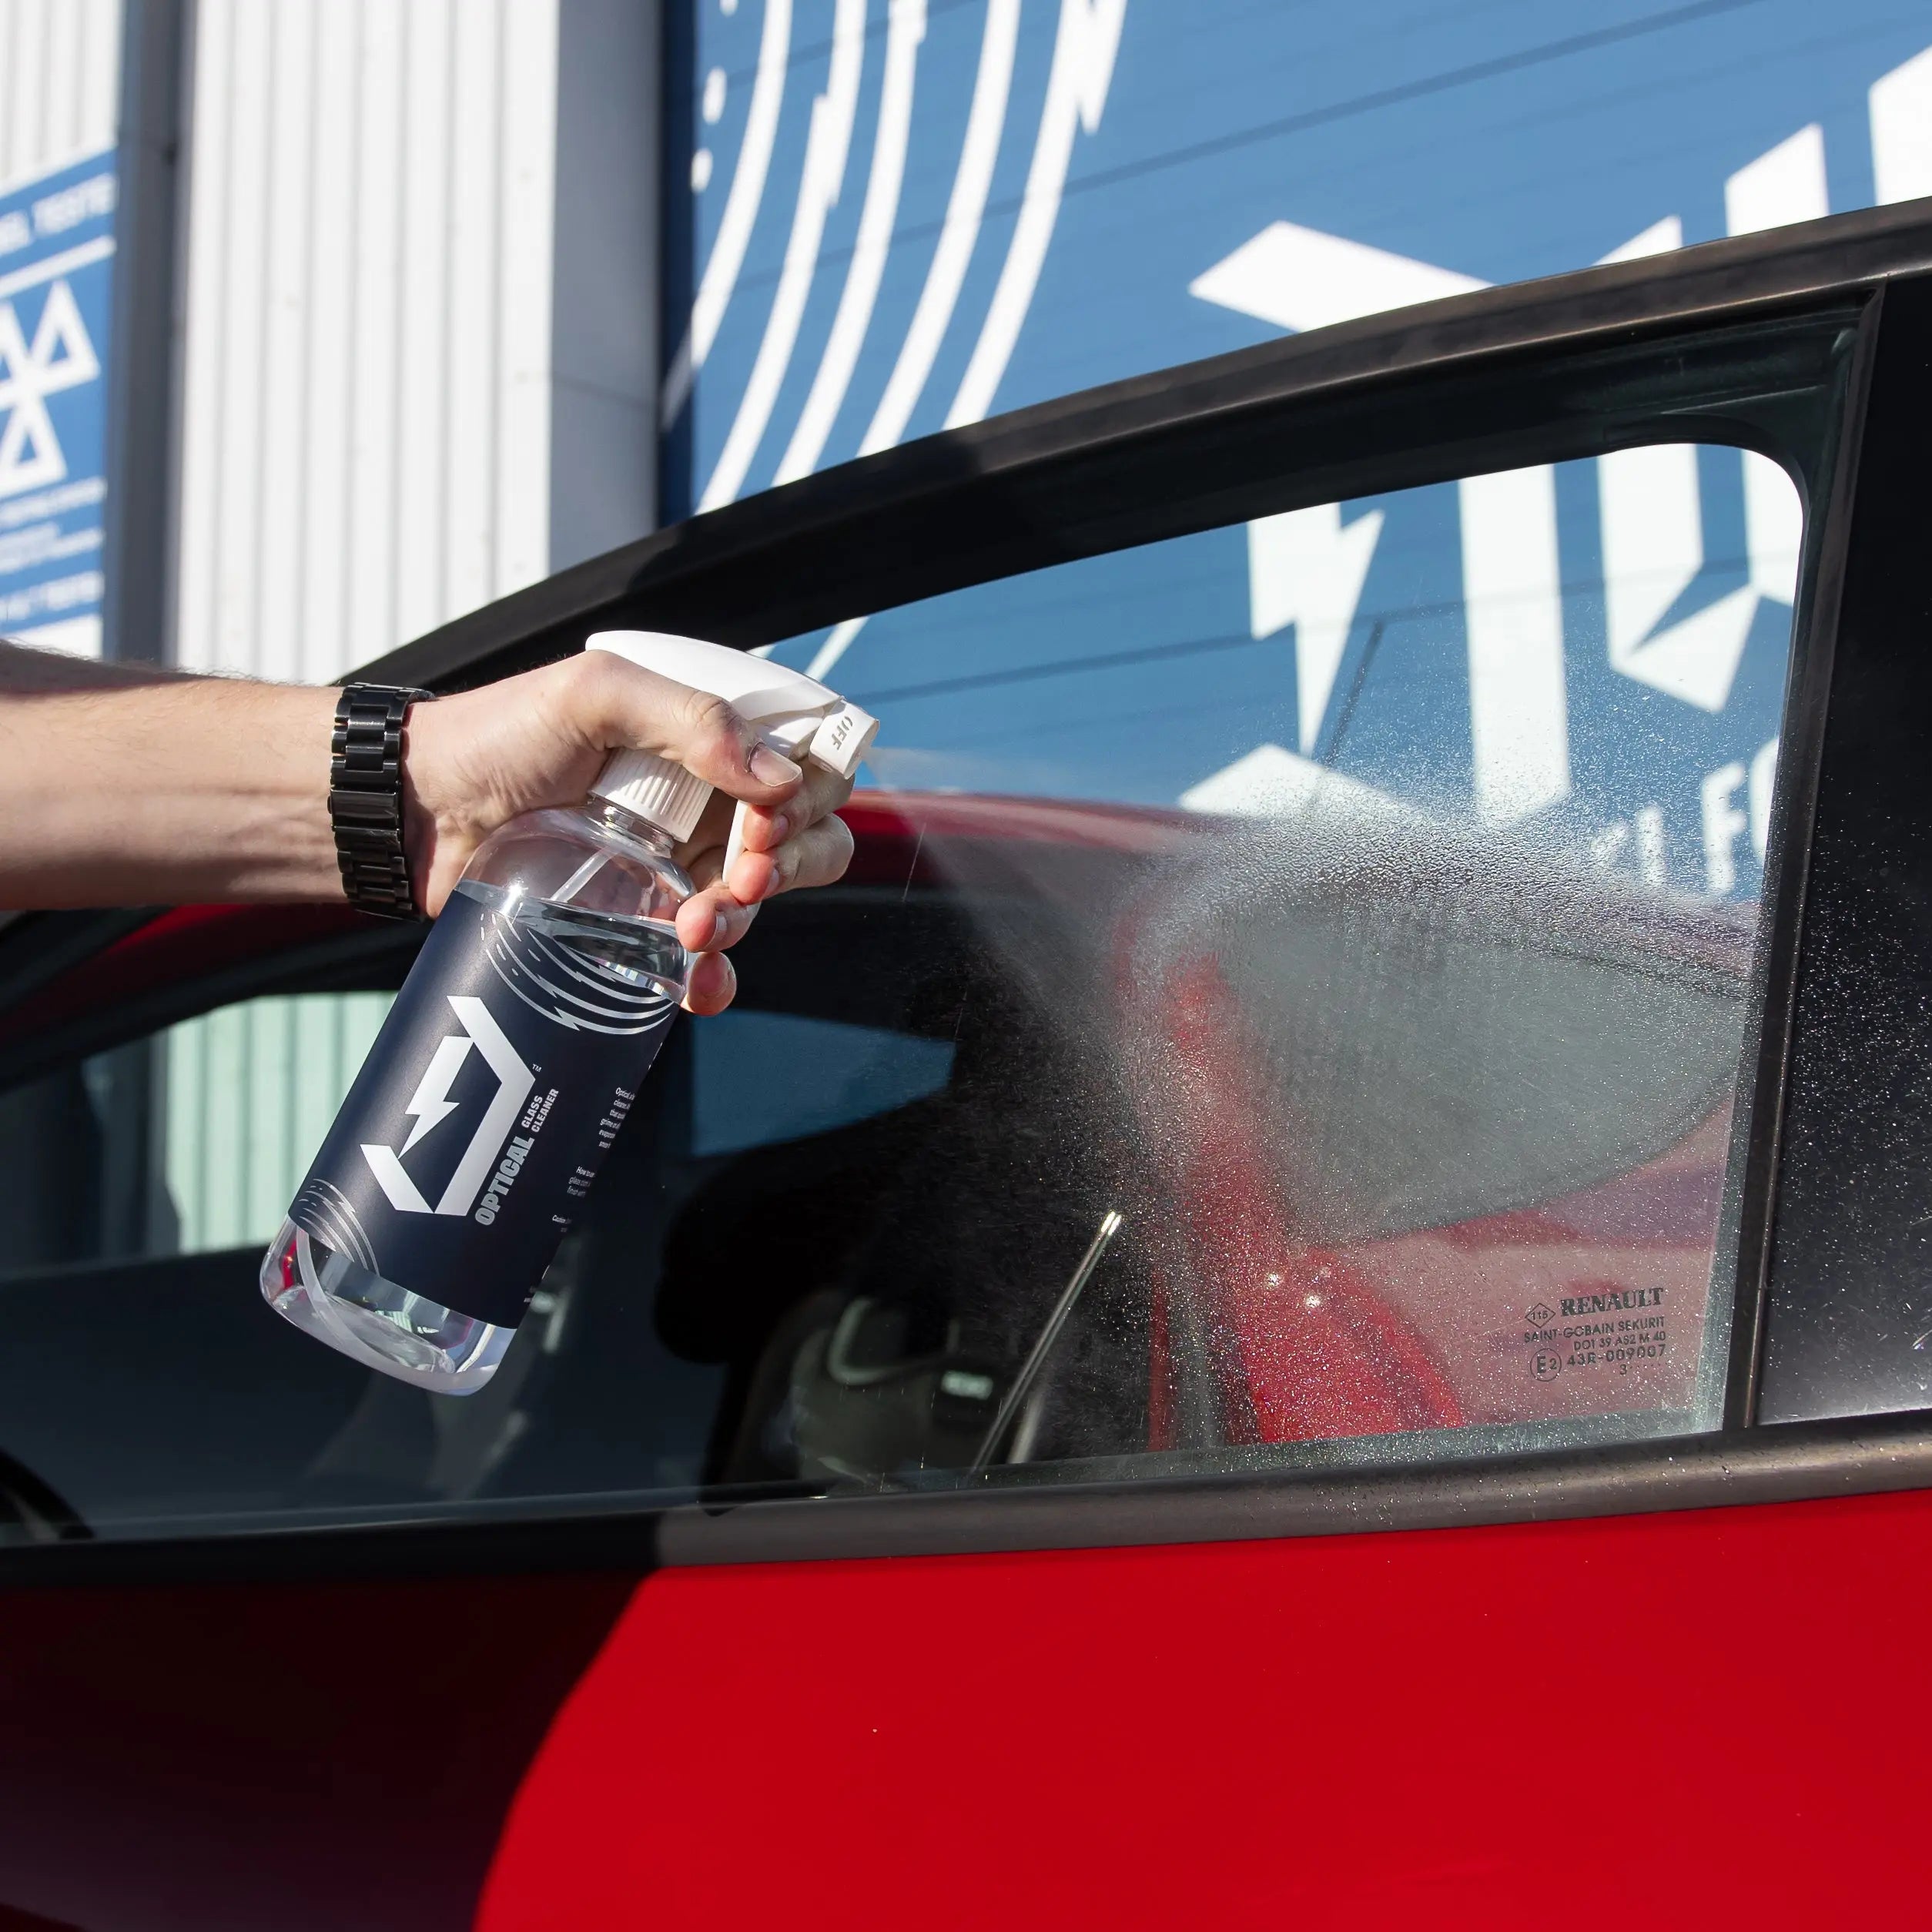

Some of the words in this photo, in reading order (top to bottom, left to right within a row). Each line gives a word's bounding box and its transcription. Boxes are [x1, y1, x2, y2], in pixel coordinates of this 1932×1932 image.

[832, 716, 853, 751] OFF
[521, 1095, 543, 1129] GLASS
[531, 1088, 560, 1133] CLEANER
[474, 1136, 536, 1226] OPTICAL
[1560, 1287, 1664, 1317] RENAULT
[1524, 1323, 1615, 1343] SAINT-GOBAIN
[1618, 1316, 1665, 1332] SEKURIT
[1574, 1339, 1595, 1351] DOT
[1615, 1334, 1636, 1346] AS2
[1639, 1333, 1650, 1343] M
